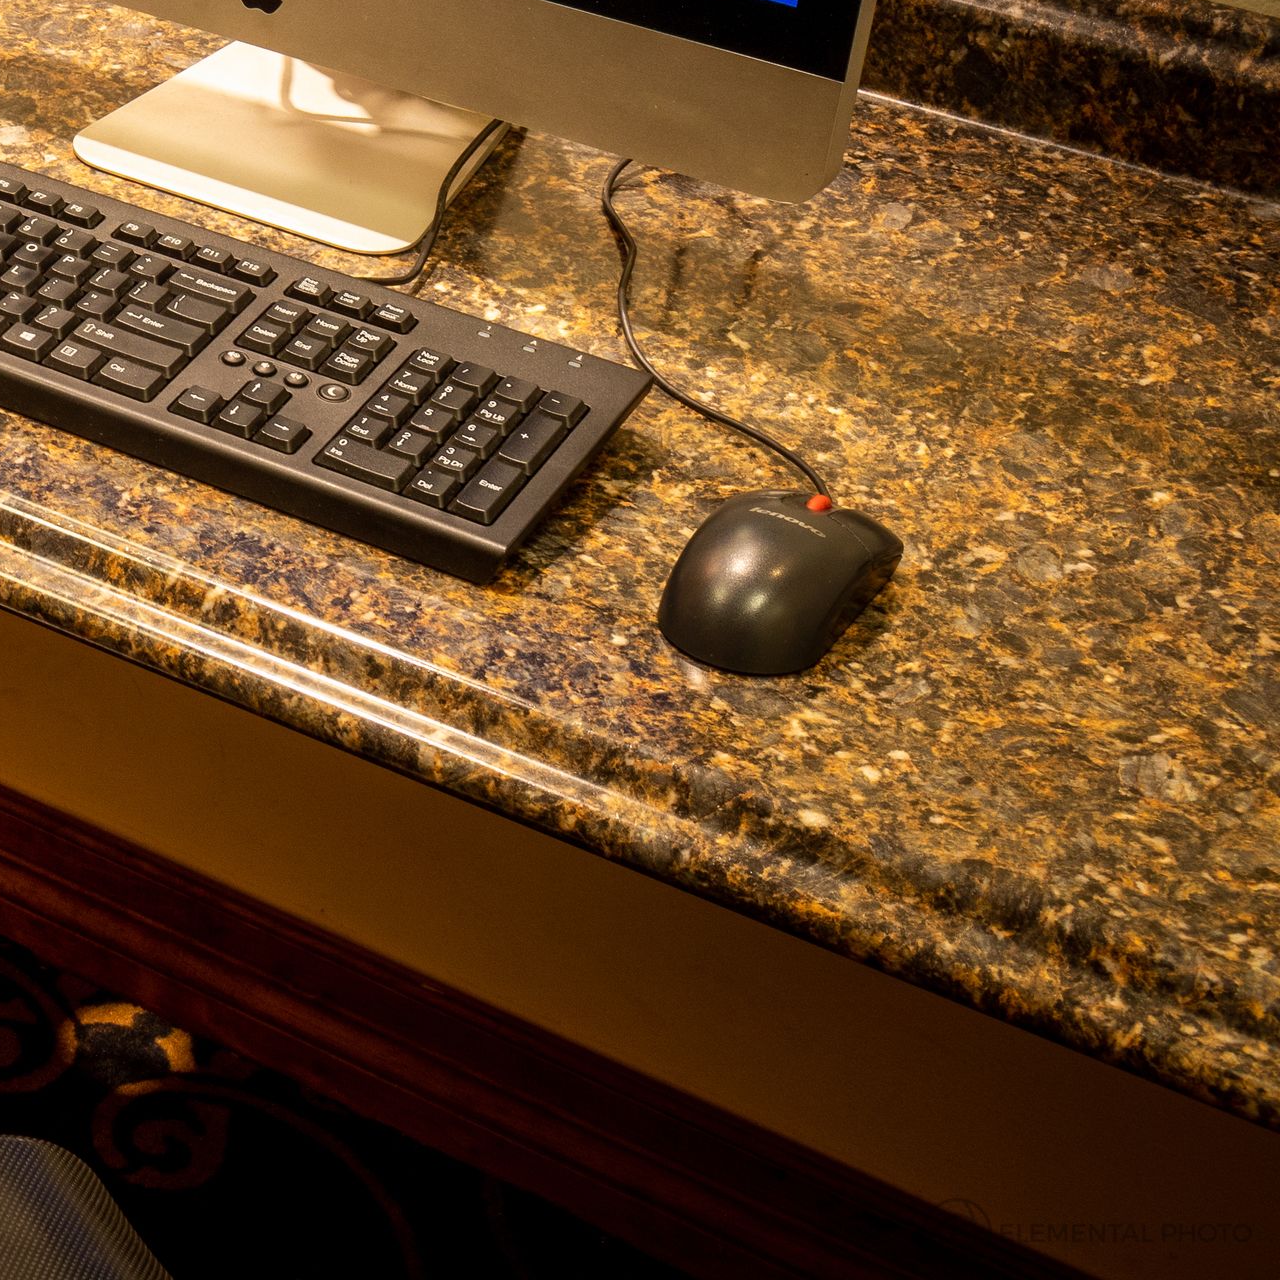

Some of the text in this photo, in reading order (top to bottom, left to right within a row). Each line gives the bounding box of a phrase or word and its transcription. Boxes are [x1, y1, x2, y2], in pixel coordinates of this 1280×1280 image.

[164, 235, 182, 245] F10
[26, 244, 38, 252] O
[203, 248, 220, 257] F11
[63, 255, 75, 263] P
[11, 266, 20, 275] L
[241, 261, 259, 271] F12
[196, 278, 237, 296] Backspace
[274, 305, 297, 317] Insert
[142, 316, 164, 329] Enter
[316, 318, 339, 330] Home
[95, 328, 114, 339] Shift
[253, 326, 277, 338] Delete
[360, 329, 380, 341] Page
[356, 335, 368, 344] Up
[294, 340, 311, 351] End
[339, 352, 359, 364] Page
[417, 356, 435, 366] Lock
[421, 351, 439, 361] Num
[110, 363, 125, 372] Ctrl
[334, 357, 357, 369] Down
[394, 379, 418, 391] Home
[480, 408, 505, 422] Pg Up
[351, 425, 369, 435] End
[439, 455, 463, 468] Pg Dn
[417, 479, 433, 490] Del
[478, 479, 502, 492] Enter
[749, 506, 826, 539] lenovo
